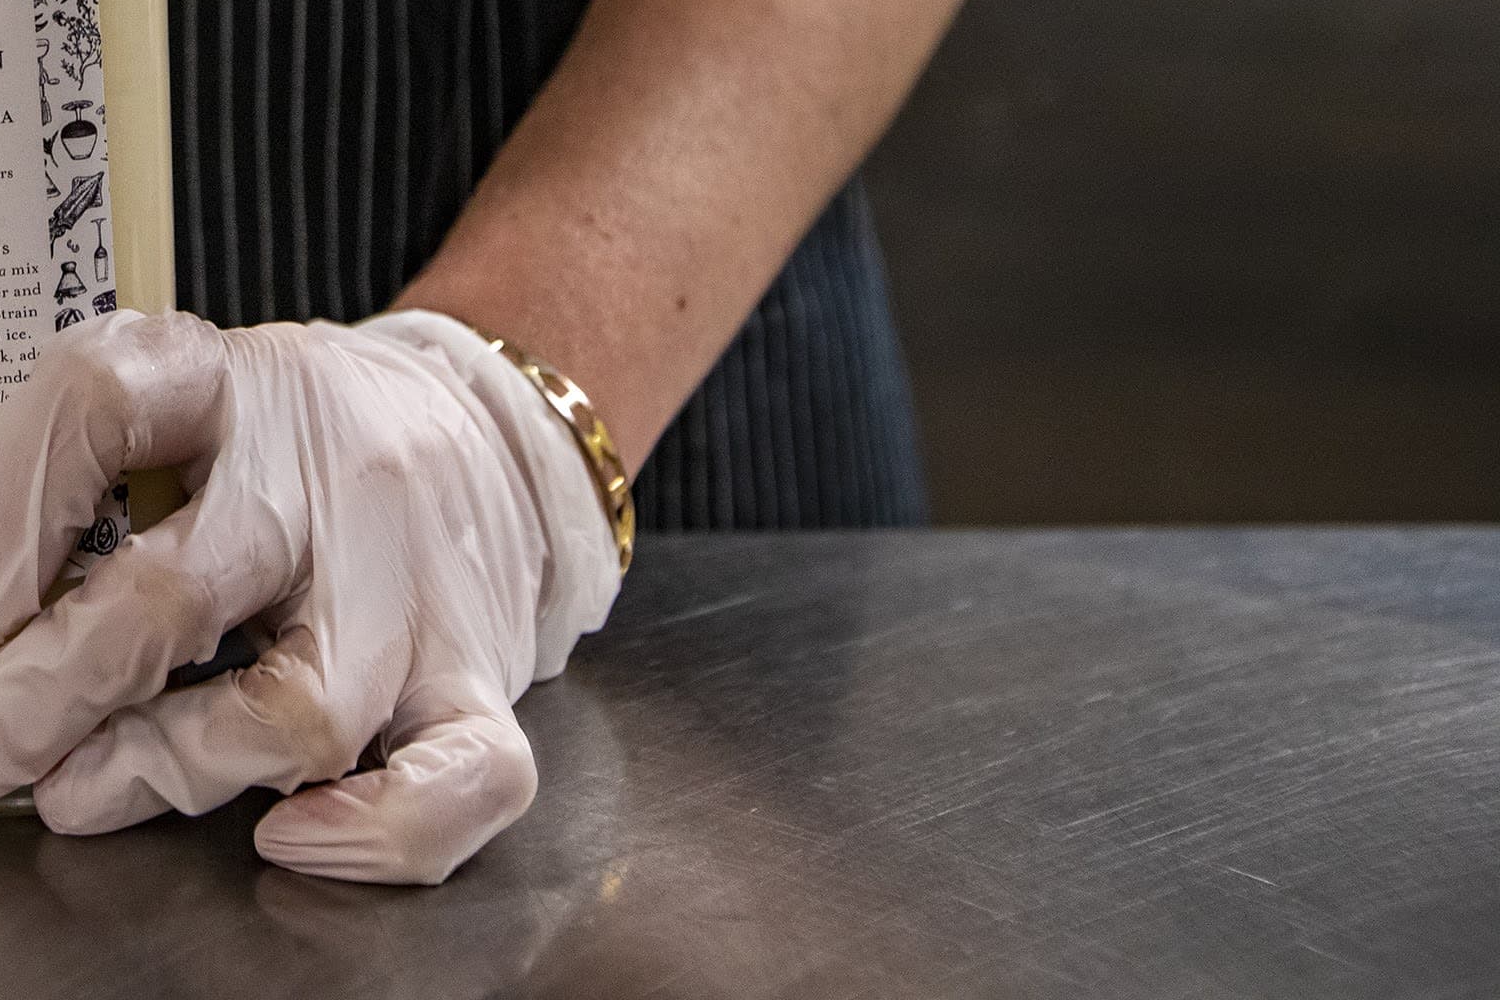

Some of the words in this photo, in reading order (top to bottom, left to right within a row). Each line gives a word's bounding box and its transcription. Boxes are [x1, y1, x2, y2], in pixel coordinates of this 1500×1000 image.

[11, 263, 39, 276] mix
[13, 282, 41, 296] and
[6, 328, 32, 340] ice.
[19, 347, 41, 361] ad
